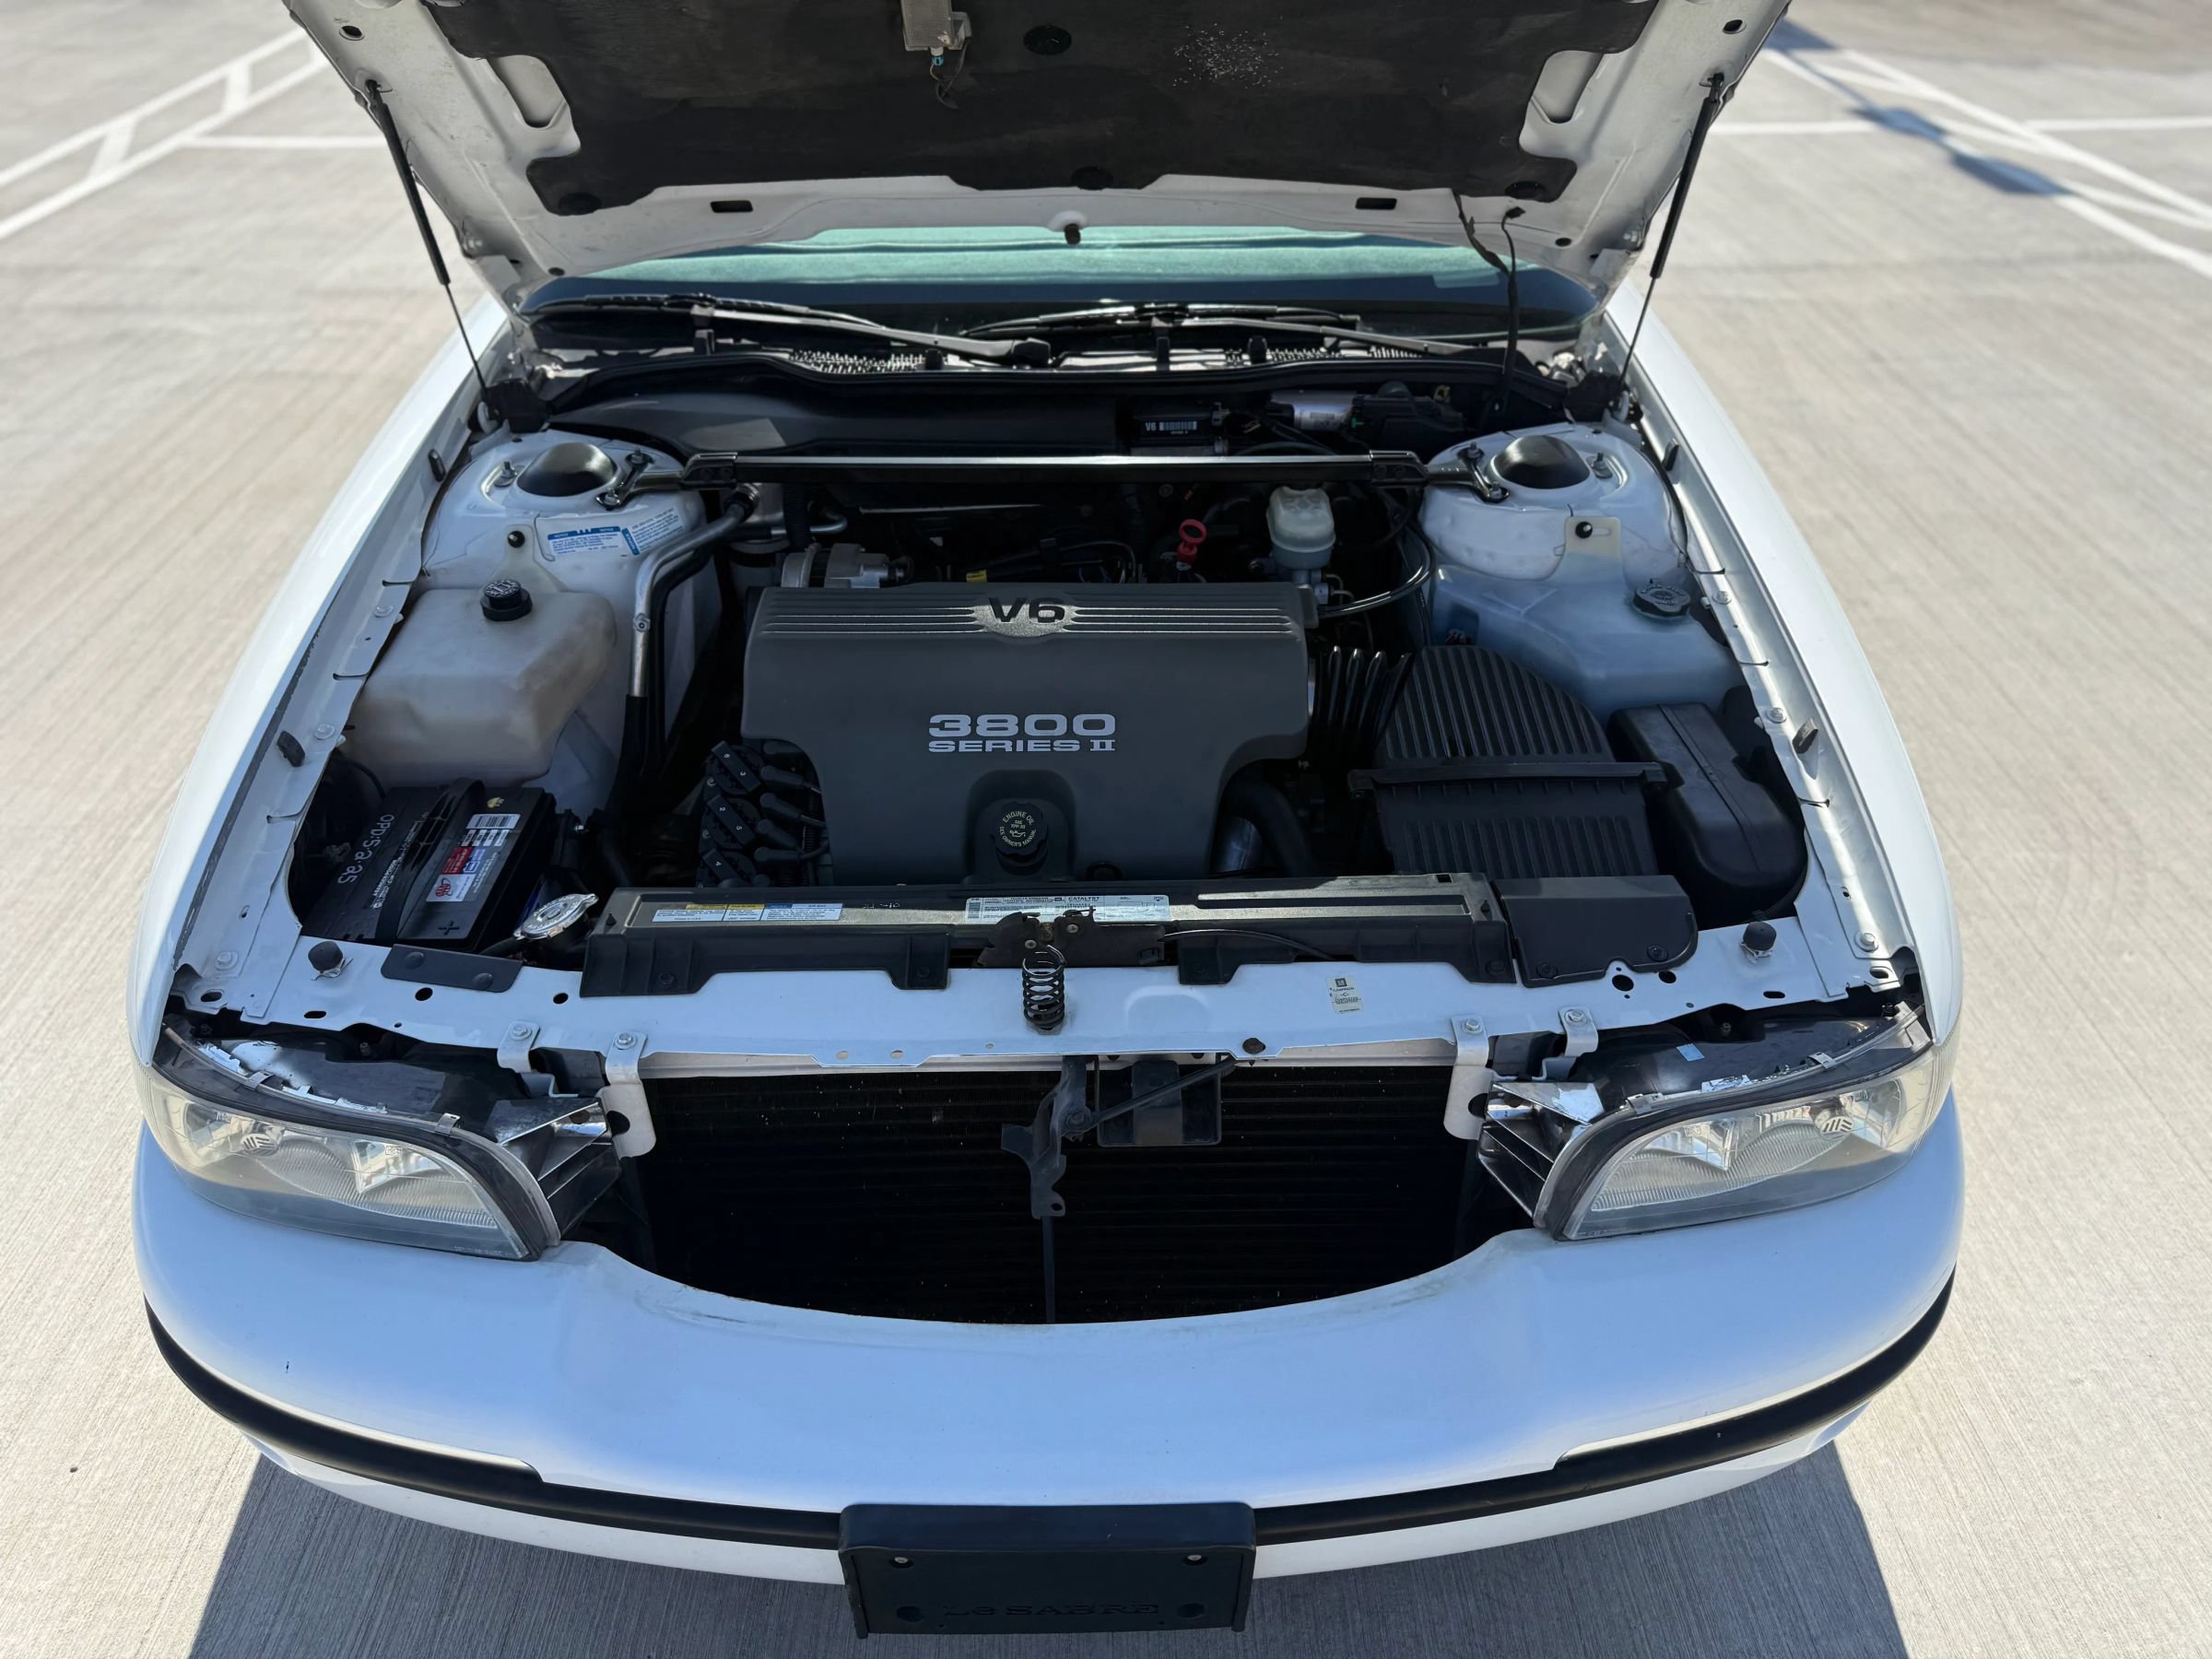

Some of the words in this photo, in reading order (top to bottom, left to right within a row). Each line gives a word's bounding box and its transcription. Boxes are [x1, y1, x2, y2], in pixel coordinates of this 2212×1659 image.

[988, 597, 1065, 624] V6
[928, 713, 1116, 737] 3800
[928, 739, 1080, 753] SERIES
[1089, 739, 1116, 752] II
[1002, 810, 1028, 823] ENGINE
